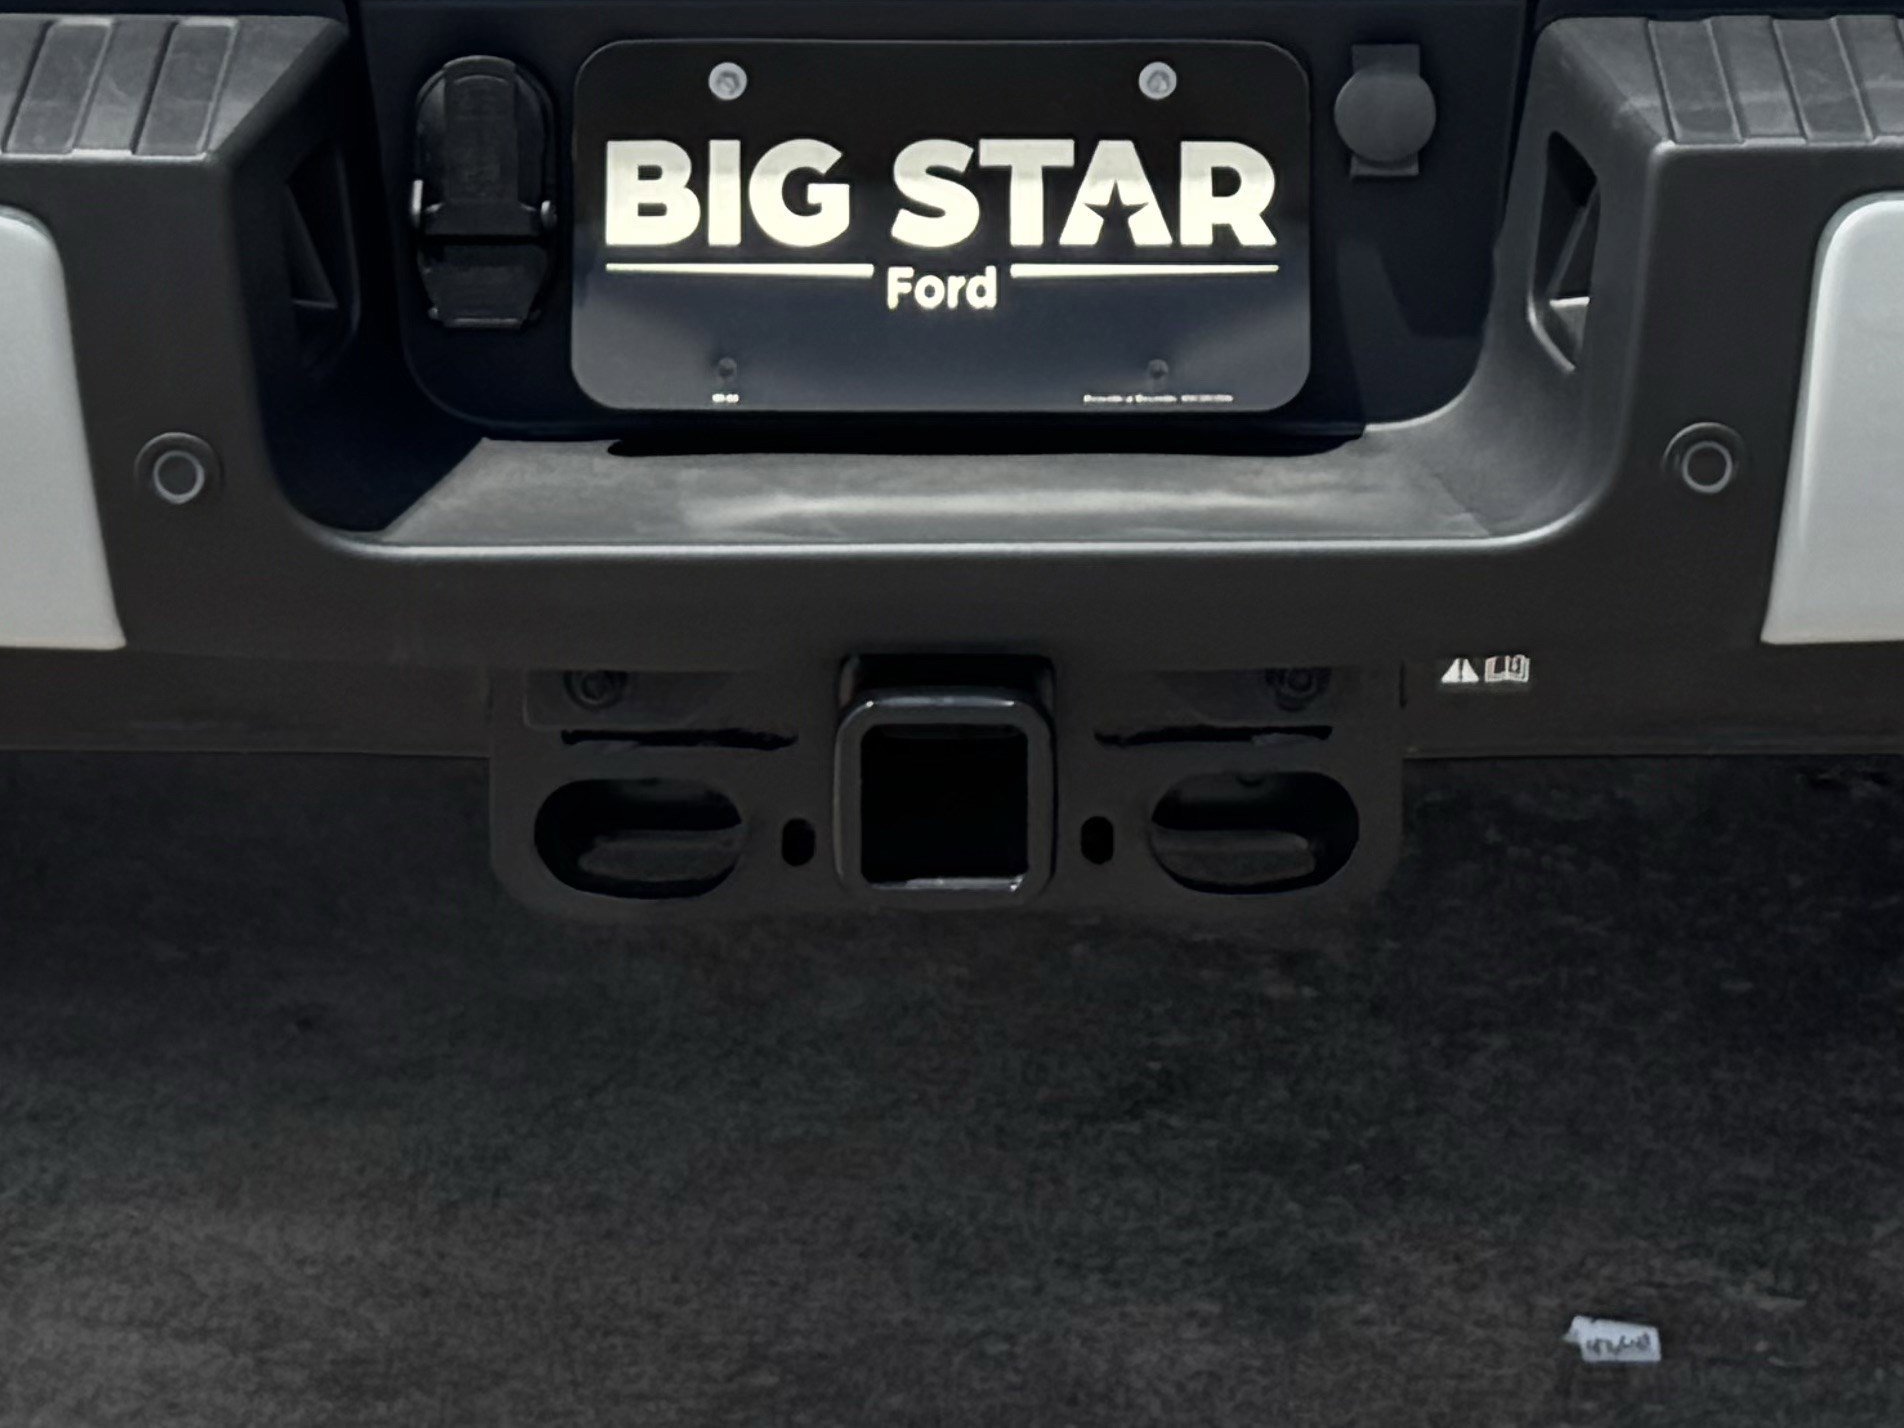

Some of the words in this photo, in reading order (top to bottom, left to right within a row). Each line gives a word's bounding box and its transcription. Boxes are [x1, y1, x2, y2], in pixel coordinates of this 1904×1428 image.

[605, 138, 851, 247] BIG
[891, 138, 1277, 247] STAR
[886, 265, 998, 311] Ford
